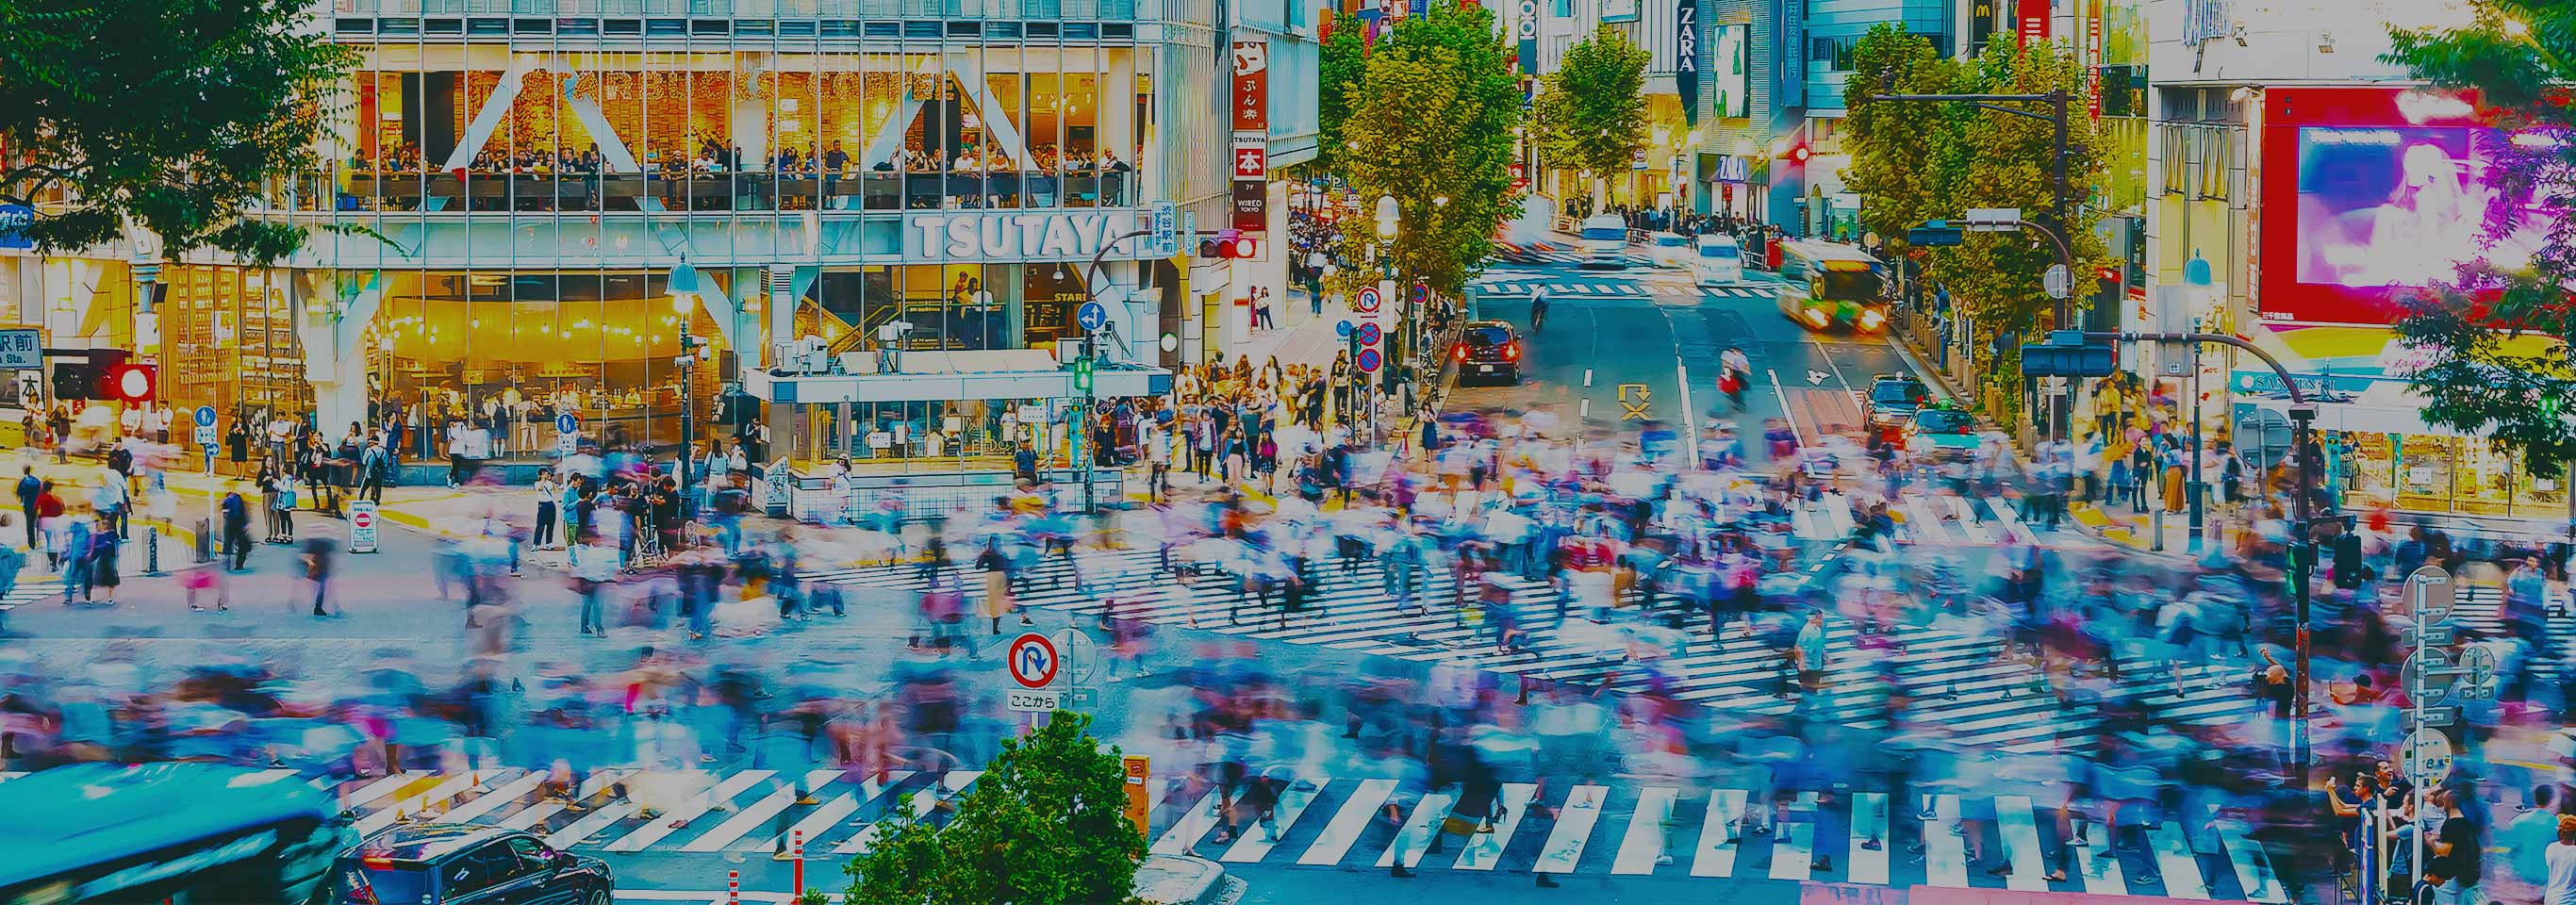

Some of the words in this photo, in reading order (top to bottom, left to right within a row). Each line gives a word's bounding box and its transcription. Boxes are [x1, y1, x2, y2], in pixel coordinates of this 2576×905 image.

[1678, 8, 1695, 72] ZARA
[806, 71, 954, 101] COFFEE
[1243, 79, 1258, 120] ぶん楽
[1238, 151, 1261, 173] 本
[914, 214, 1131, 258] TSUTAYA
[6, 354, 26, 364] Sta.
[2256, 376, 2337, 392] SANENI
[1011, 695, 1056, 709] ここから
